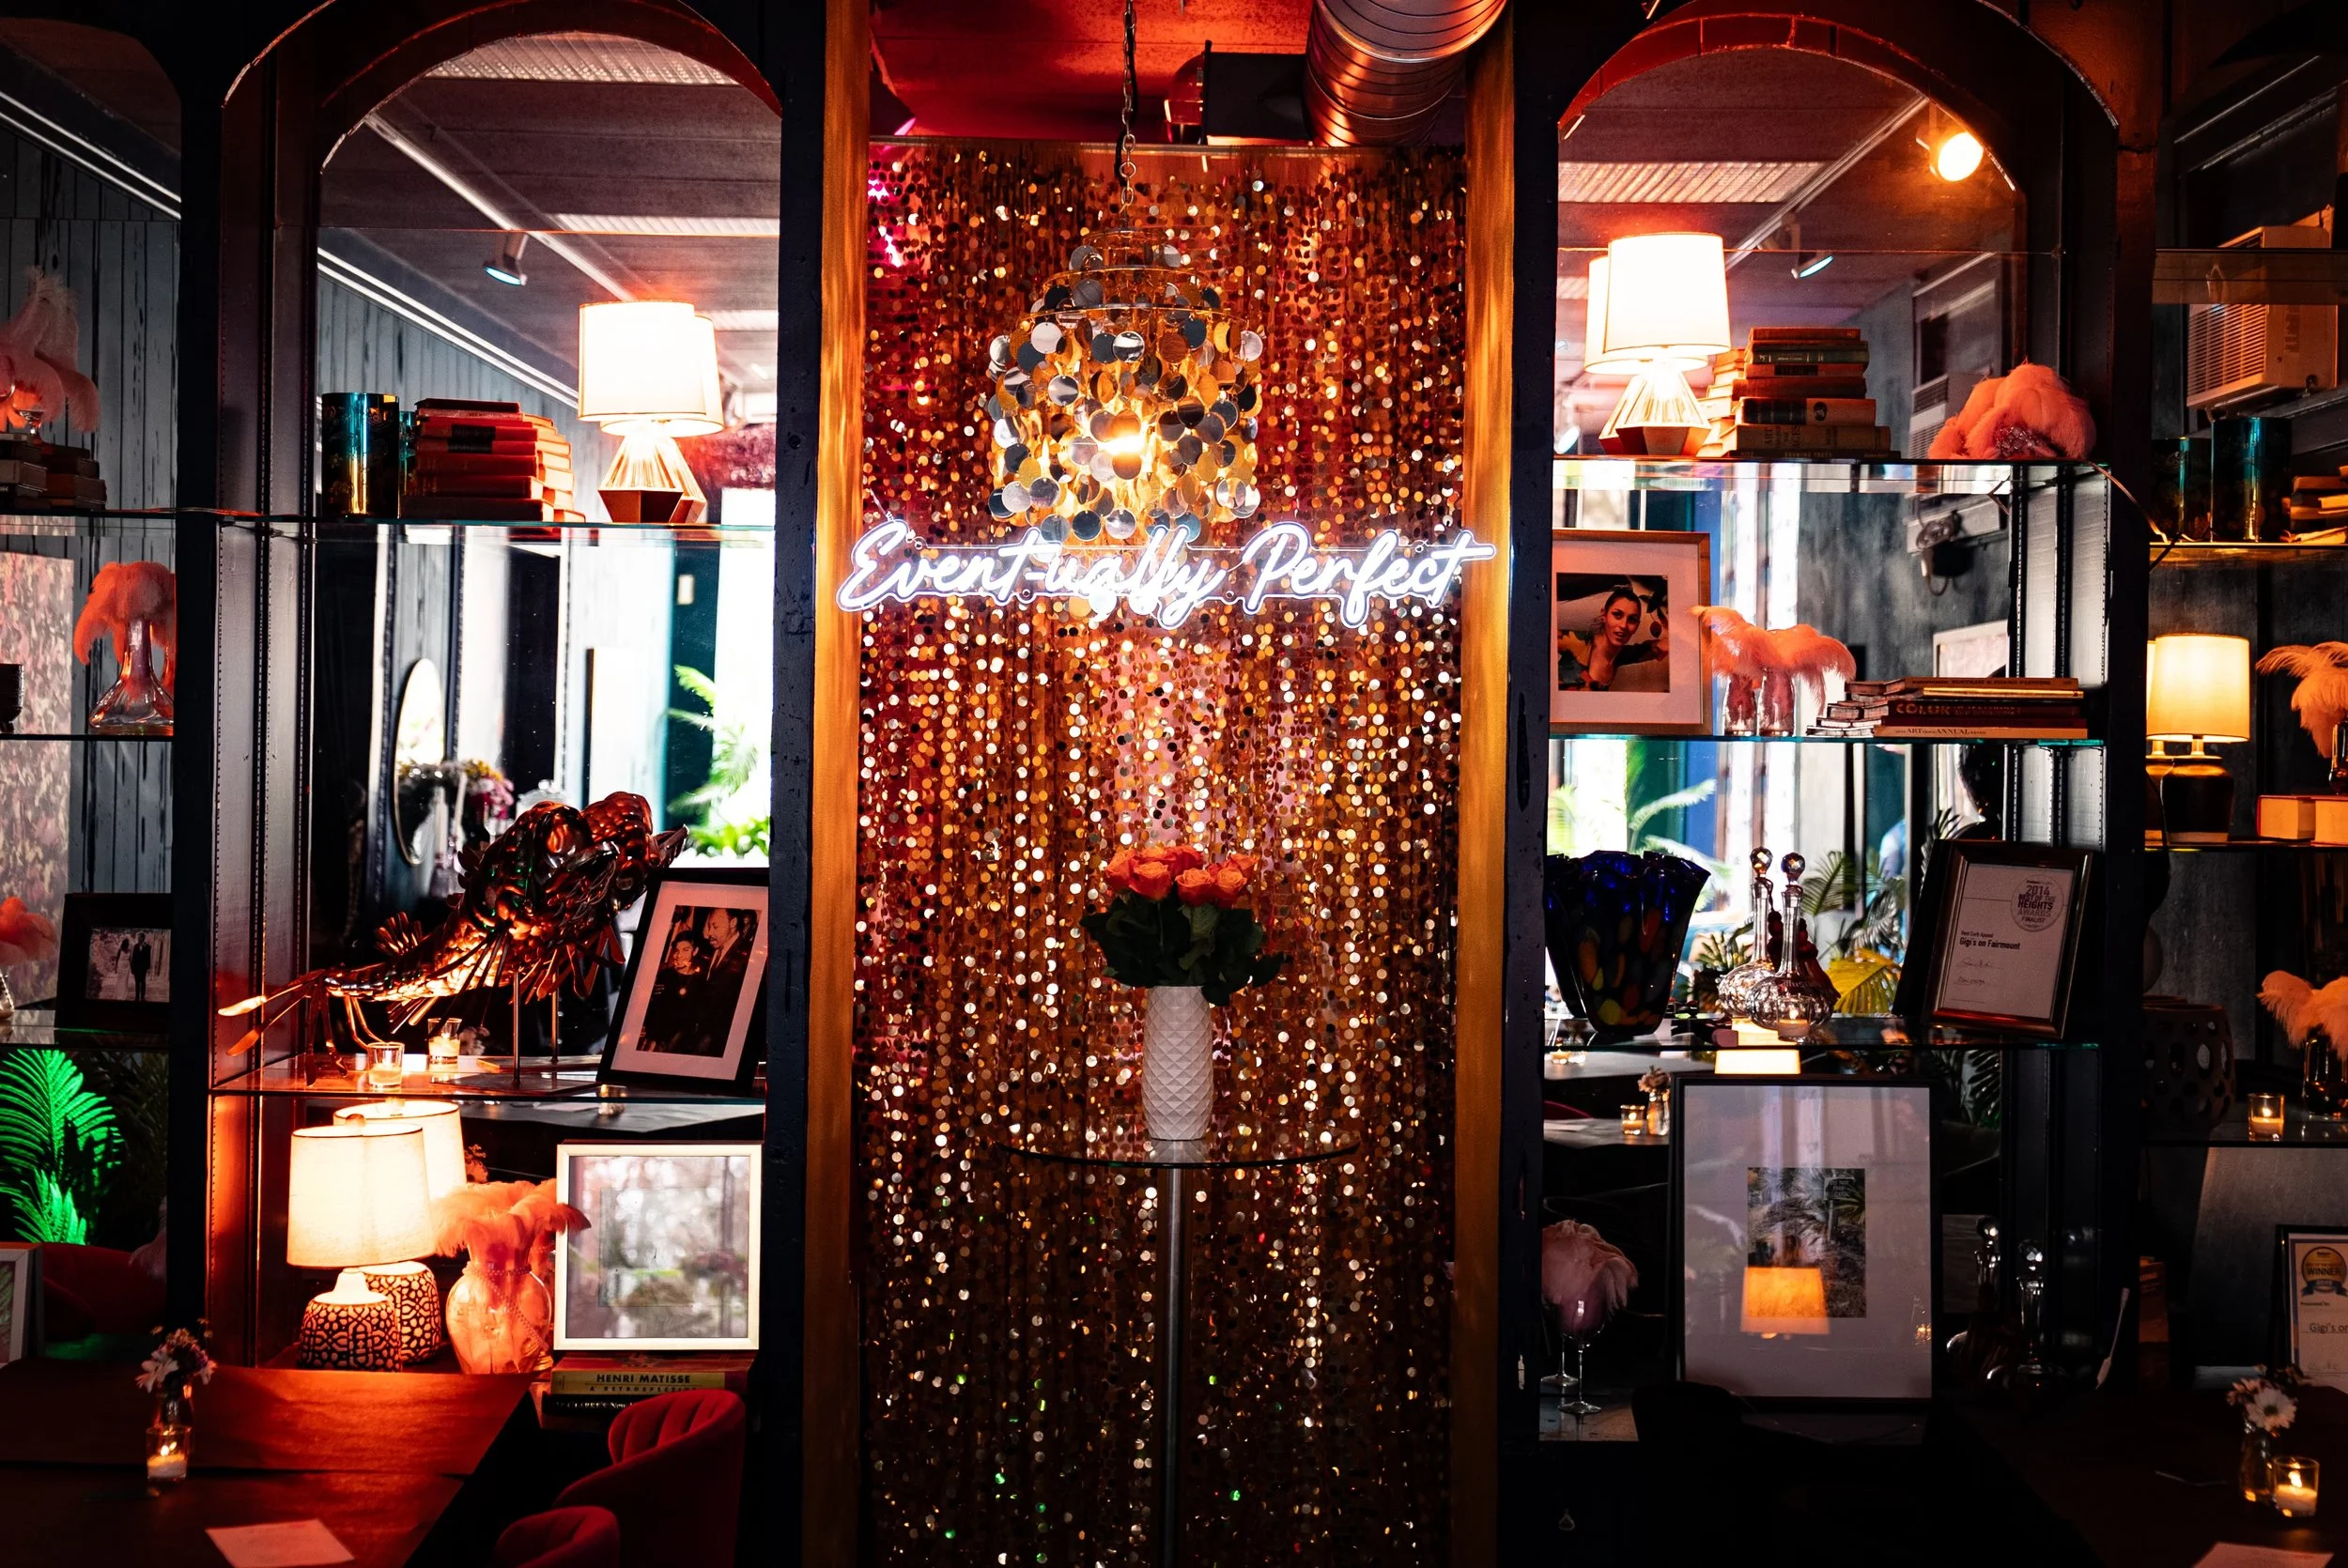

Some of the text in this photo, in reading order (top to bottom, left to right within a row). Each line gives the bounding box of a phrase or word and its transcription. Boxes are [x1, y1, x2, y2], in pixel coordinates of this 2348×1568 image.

[1230, 524, 1497, 627] Perfect
[1895, 703, 1952, 715] COLOR
[2027, 885, 2050, 896] 2014
[2017, 900, 2053, 911] HEIGHTS
[2017, 908, 2051, 917] AWARDS
[2021, 915, 2046, 924] FINALIST
[1959, 937, 1977, 947] Gigi's
[1987, 939, 2021, 950] Fairmount
[2307, 1268, 2341, 1276] WINNER
[2309, 1321, 2336, 1334] Gigi's
[596, 1374, 691, 1385] HENRI MATISSE
